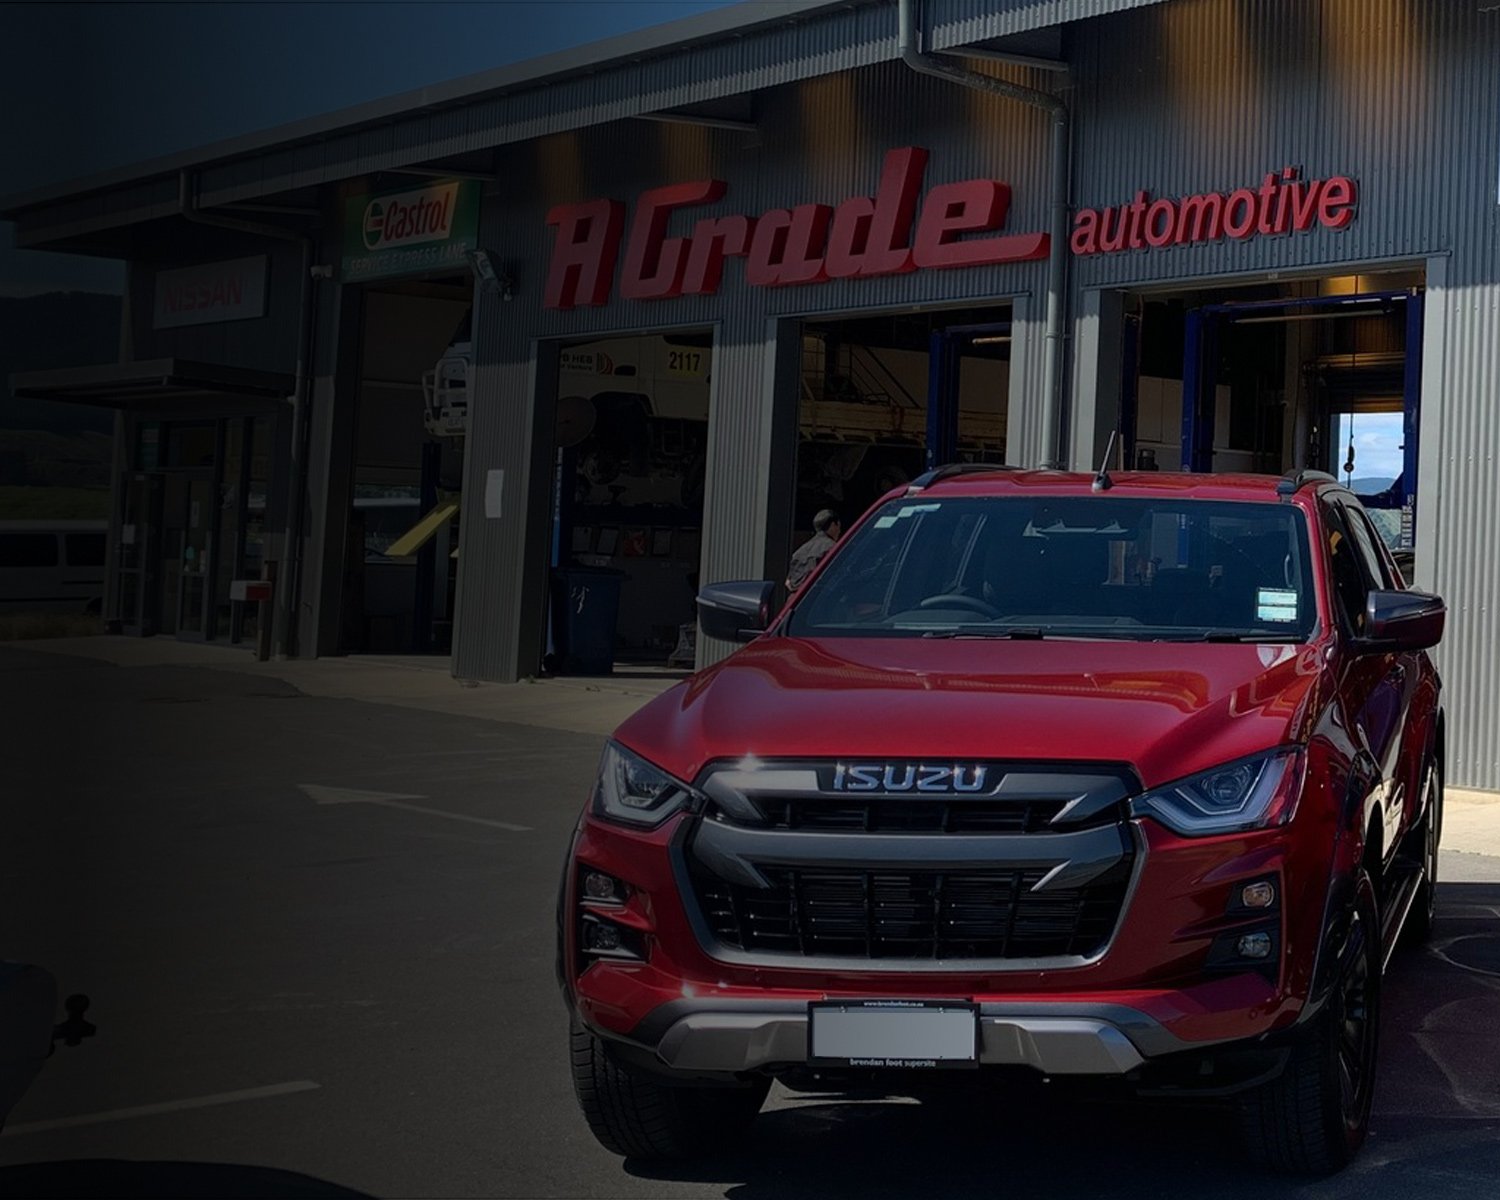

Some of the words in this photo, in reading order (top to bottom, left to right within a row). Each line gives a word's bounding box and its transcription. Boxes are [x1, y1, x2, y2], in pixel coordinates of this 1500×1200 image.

[383, 190, 451, 242] Castrol
[544, 198, 625, 312] A
[619, 145, 1051, 300] Grade
[1070, 165, 1357, 256] automotive
[350, 253, 391, 274] SERVICE
[392, 246, 437, 269] EXPRESS
[439, 241, 467, 262] LANE
[163, 273, 241, 313] NISSAN
[669, 351, 700, 371] 2117
[833, 763, 988, 791] ISUZU
[850, 1059, 884, 1067] brendan
[886, 1059, 903, 1067] foot
